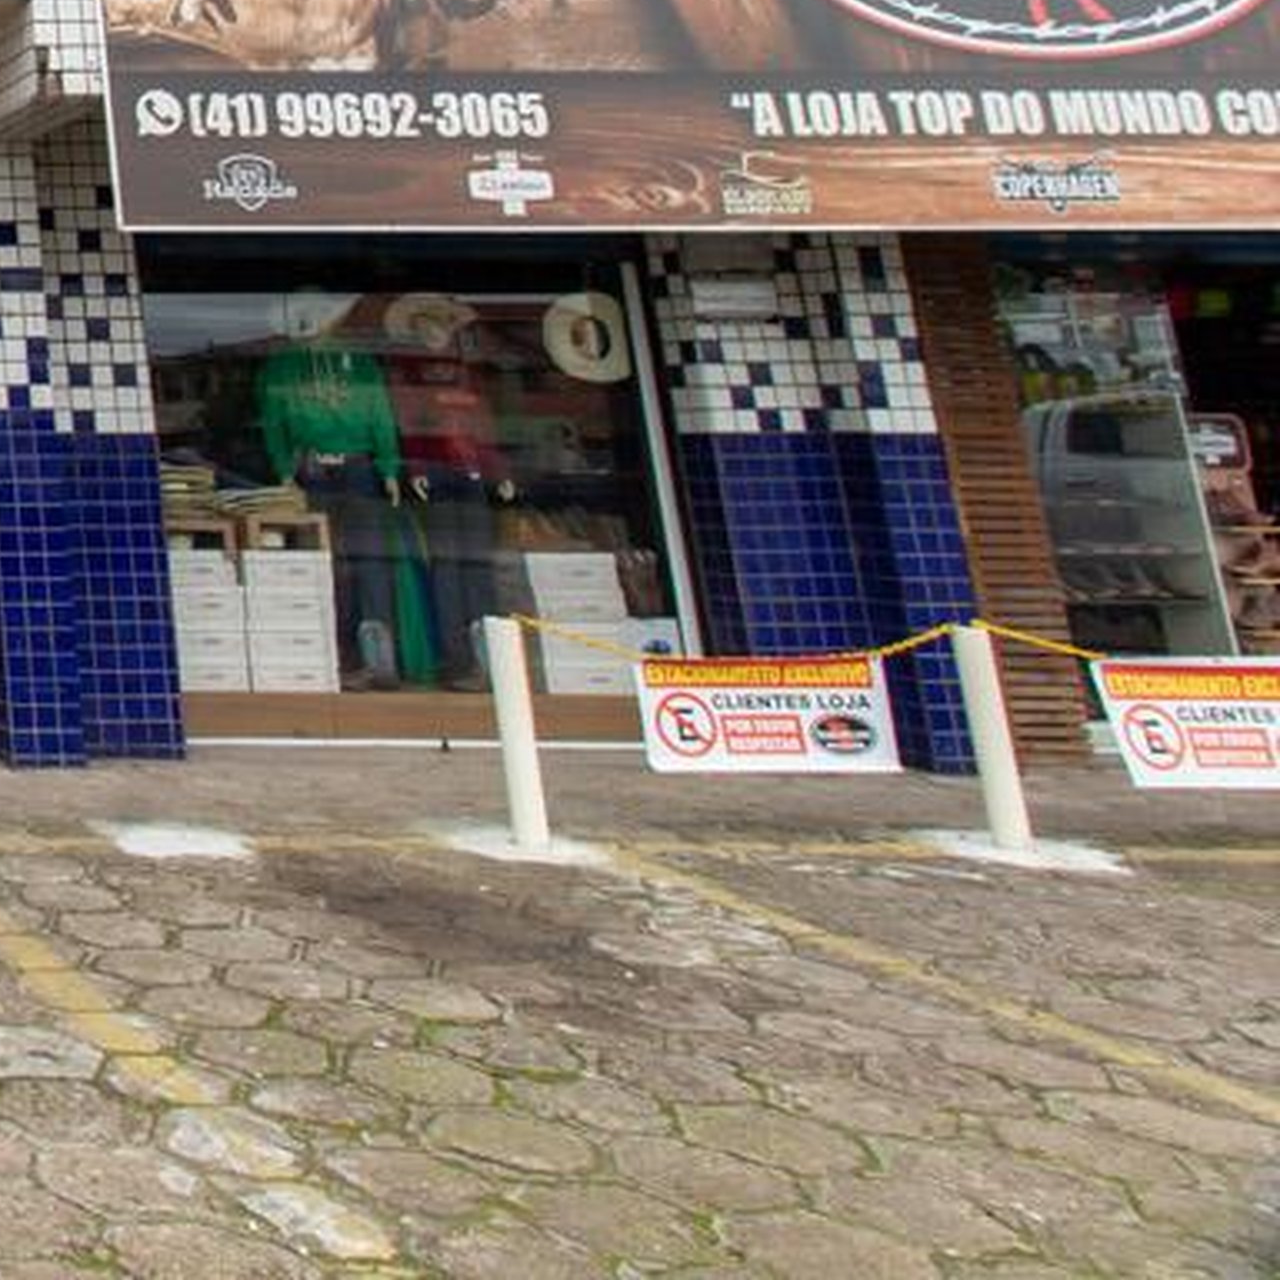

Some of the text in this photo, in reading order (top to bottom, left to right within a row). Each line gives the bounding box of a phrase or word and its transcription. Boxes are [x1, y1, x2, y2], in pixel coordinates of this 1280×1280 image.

[188, 91, 549, 138] (41) 99692-3065
[792, 91, 888, 135] LOJA
[887, 90, 973, 135] TOP
[980, 90, 1040, 135] DO
[1048, 89, 1211, 135] MUNDO
[1216, 89, 1280, 135] CO
[711, 691, 871, 710] CLIENTES LOJA
